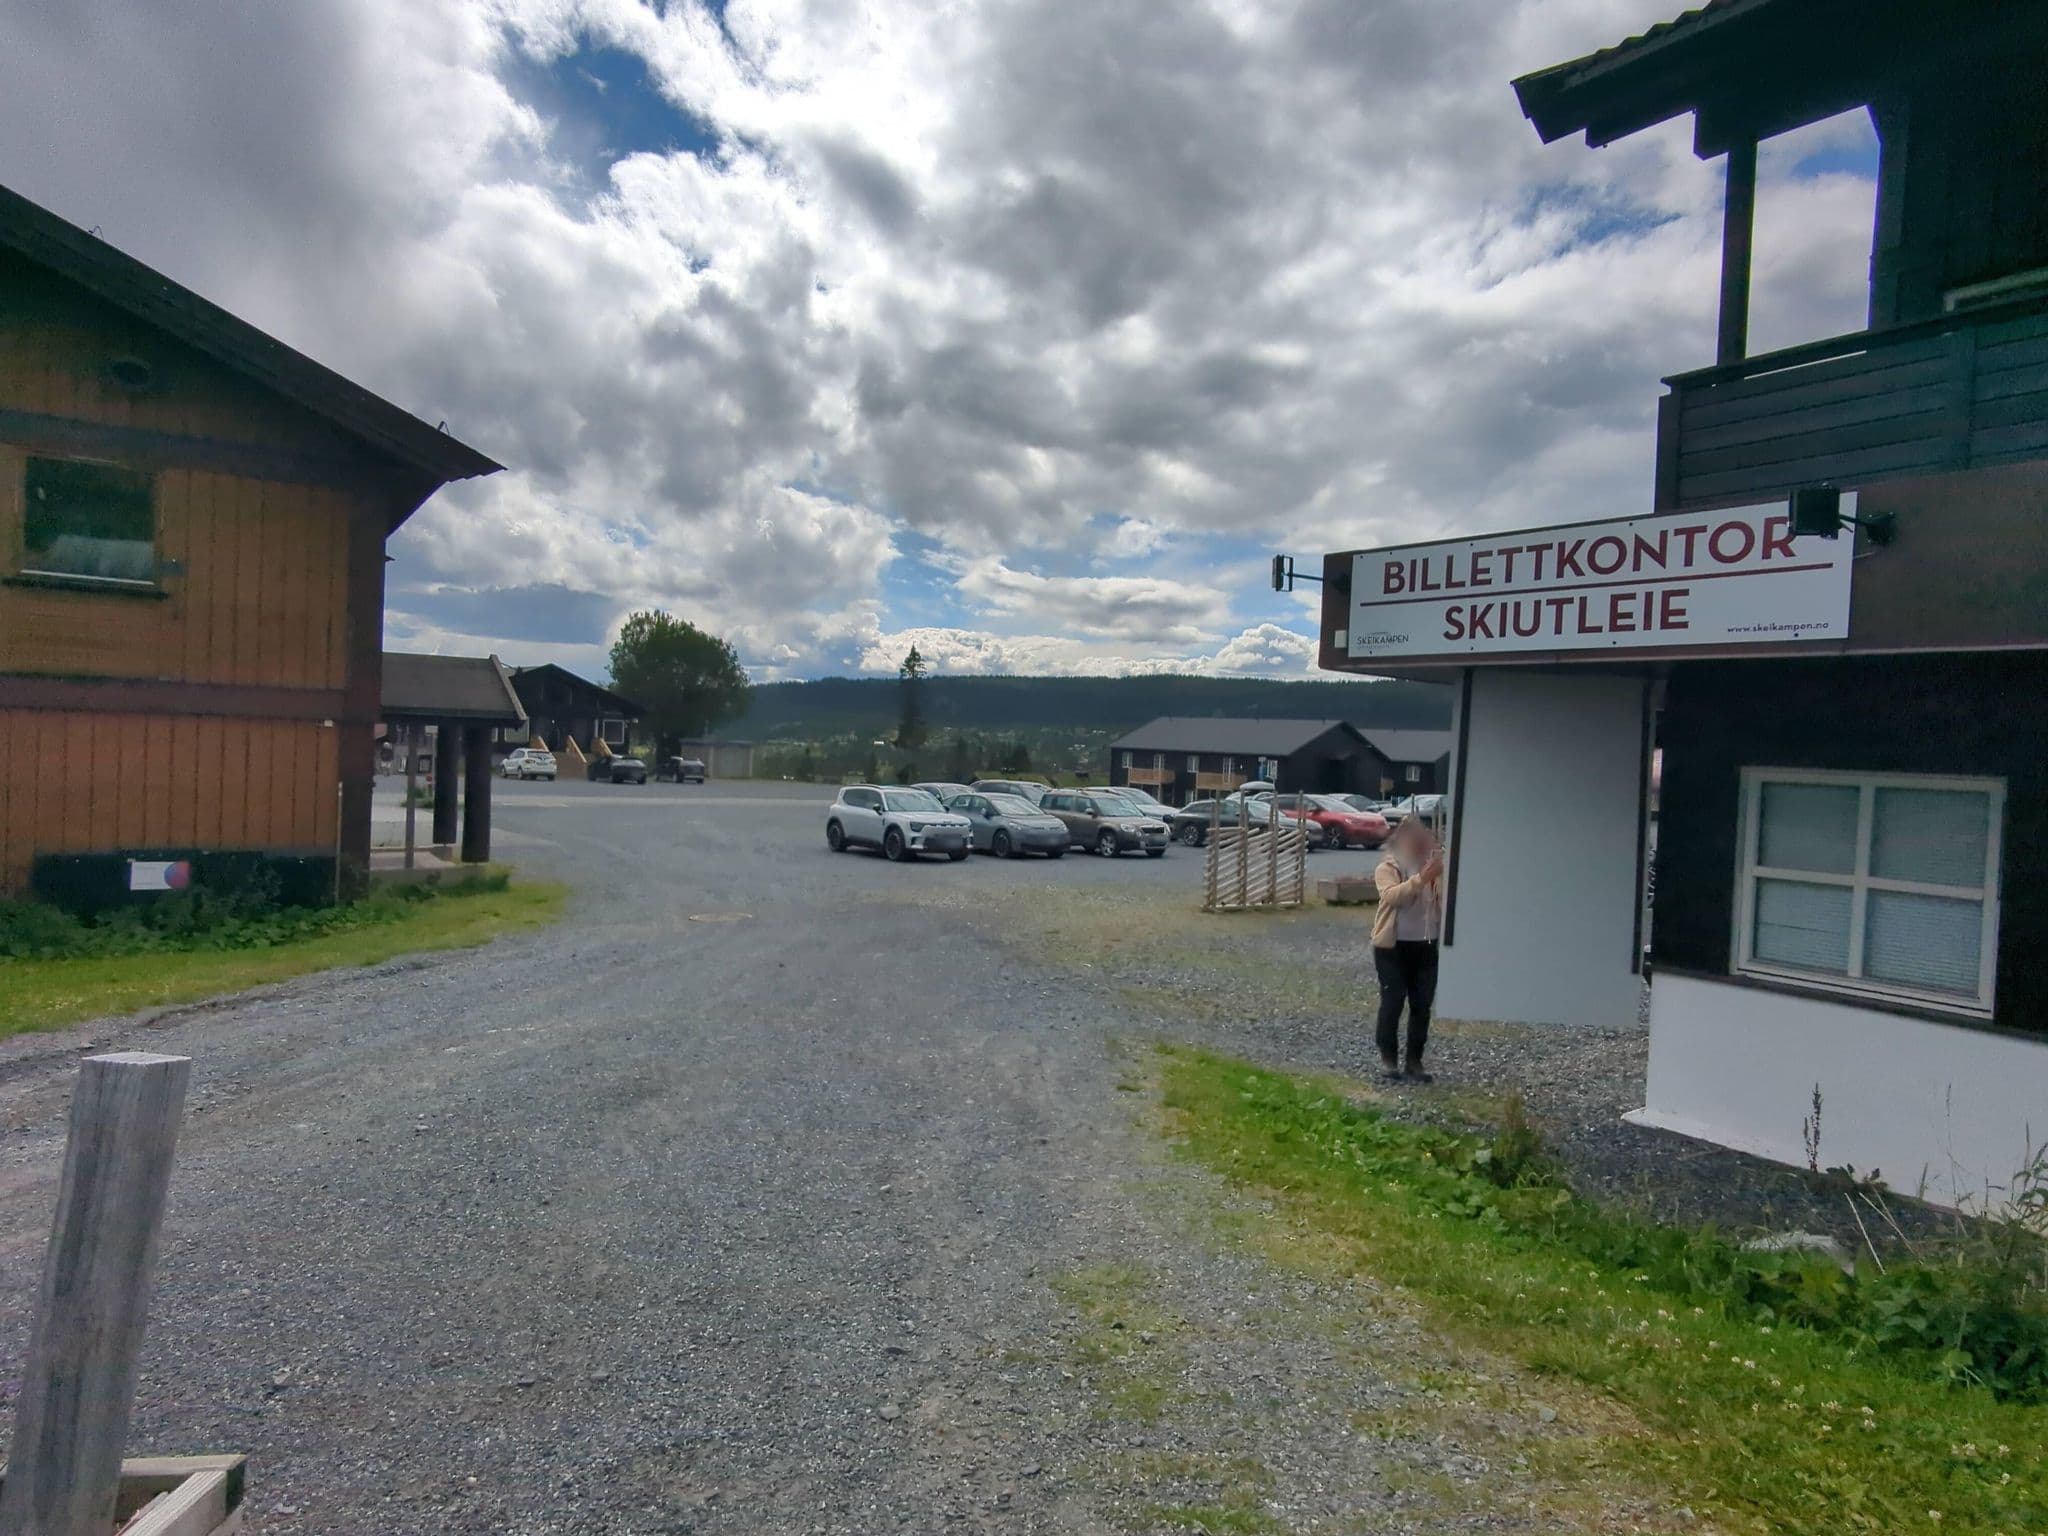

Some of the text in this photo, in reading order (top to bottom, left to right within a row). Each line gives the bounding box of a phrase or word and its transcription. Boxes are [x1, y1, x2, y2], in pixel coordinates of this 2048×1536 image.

[1383, 515, 1798, 595] BILLETTKONTOR
[1442, 588, 1690, 641] SKIUTLEIE
[1727, 622, 1829, 633] www.skeikampen.no
